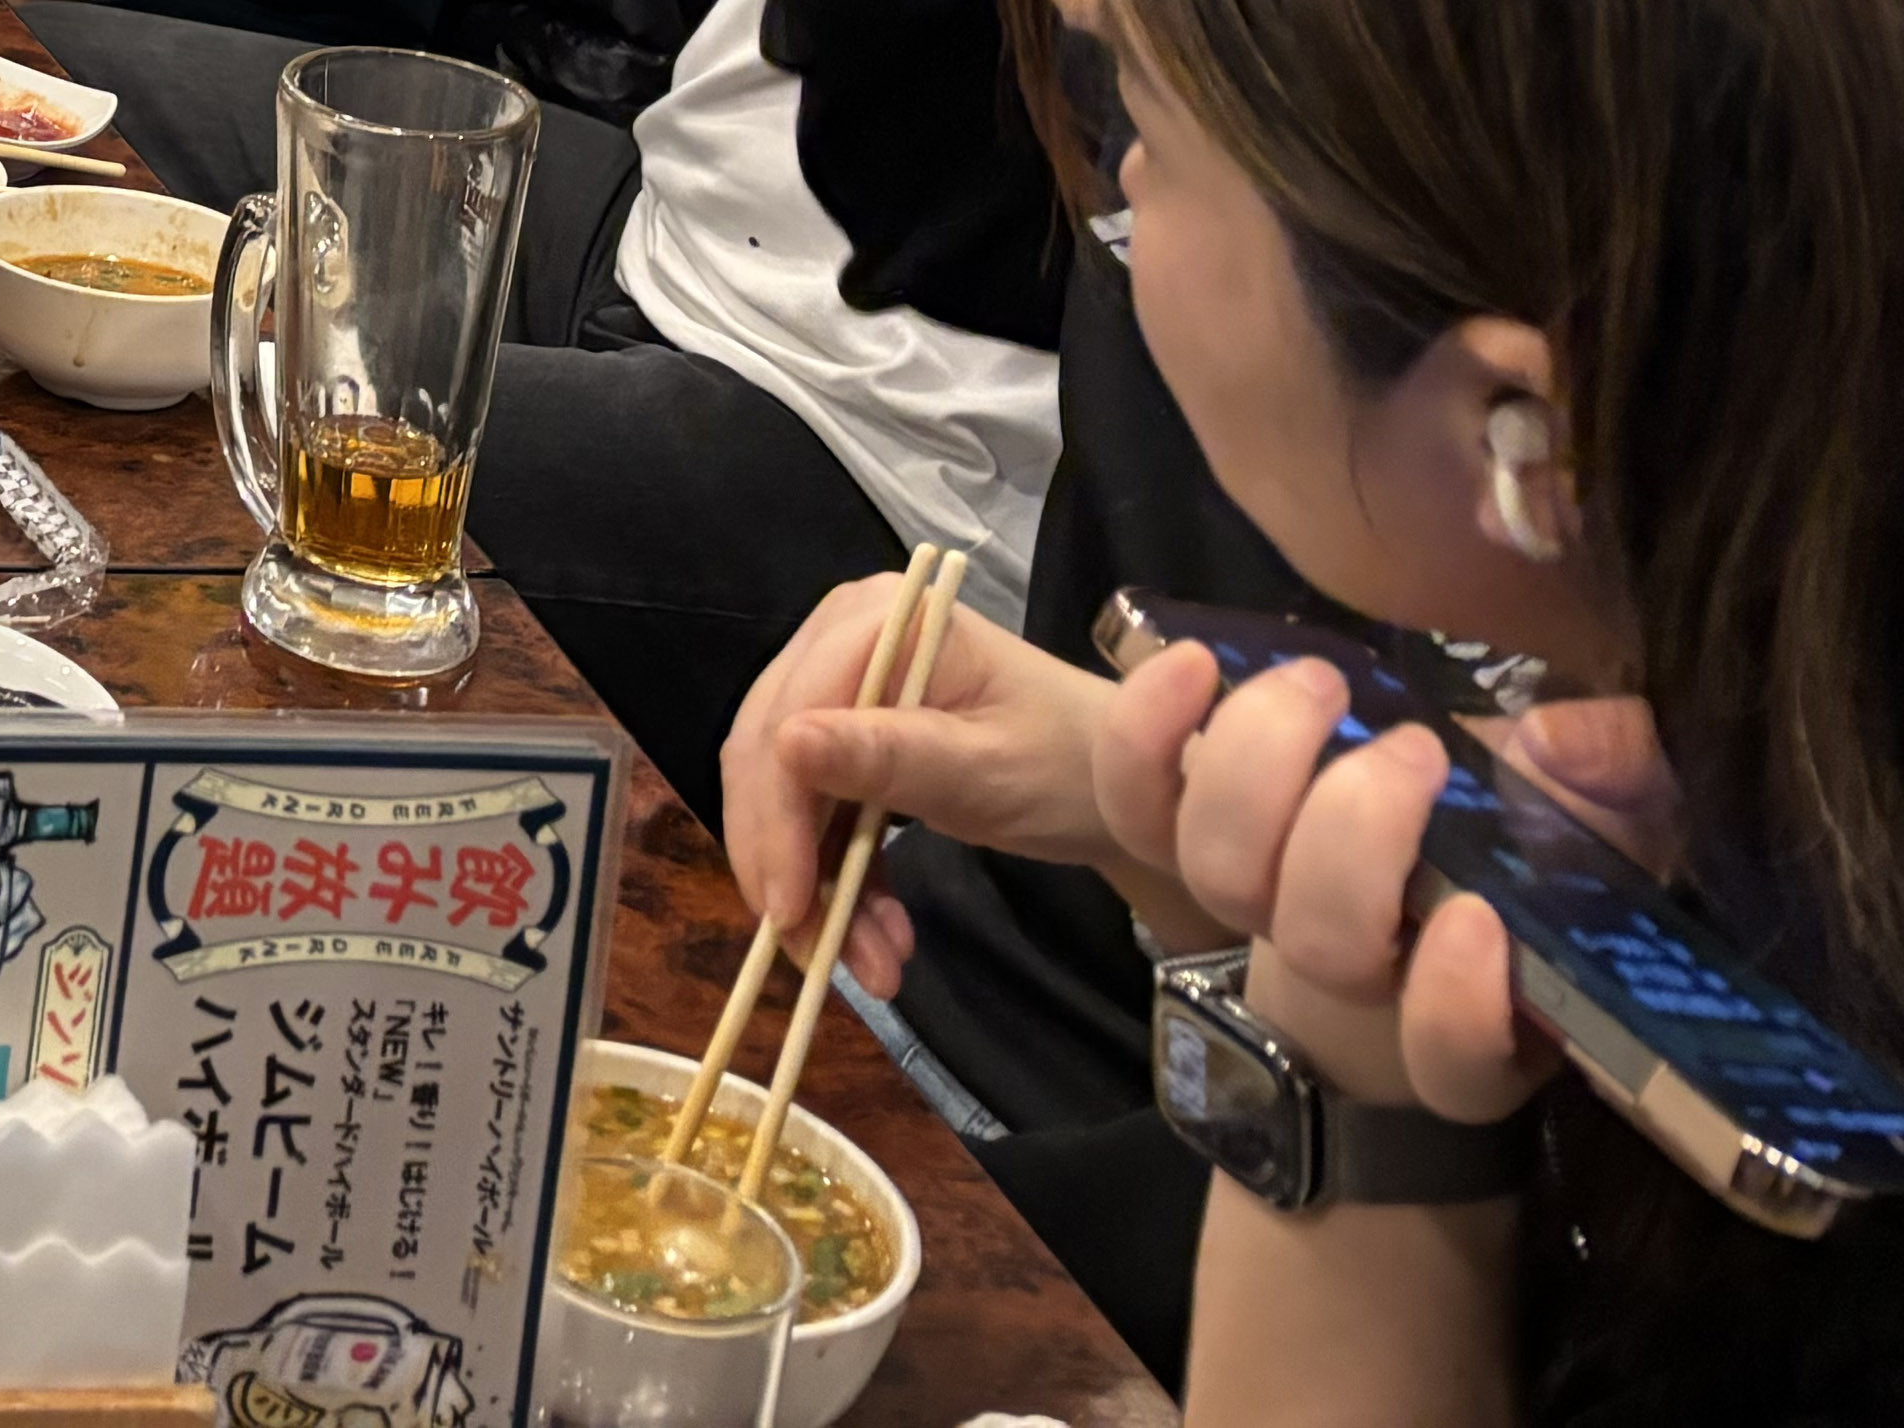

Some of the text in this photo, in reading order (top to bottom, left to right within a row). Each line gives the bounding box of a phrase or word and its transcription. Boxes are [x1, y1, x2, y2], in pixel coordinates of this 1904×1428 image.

[260, 792, 477, 821] FREE DRINK
[186, 835, 536, 930] 飲み放題
[376, 939, 460, 967] FREE
[242, 998, 327, 1275] ジムビーム
[320, 999, 375, 1271] スタンダードハイボール
